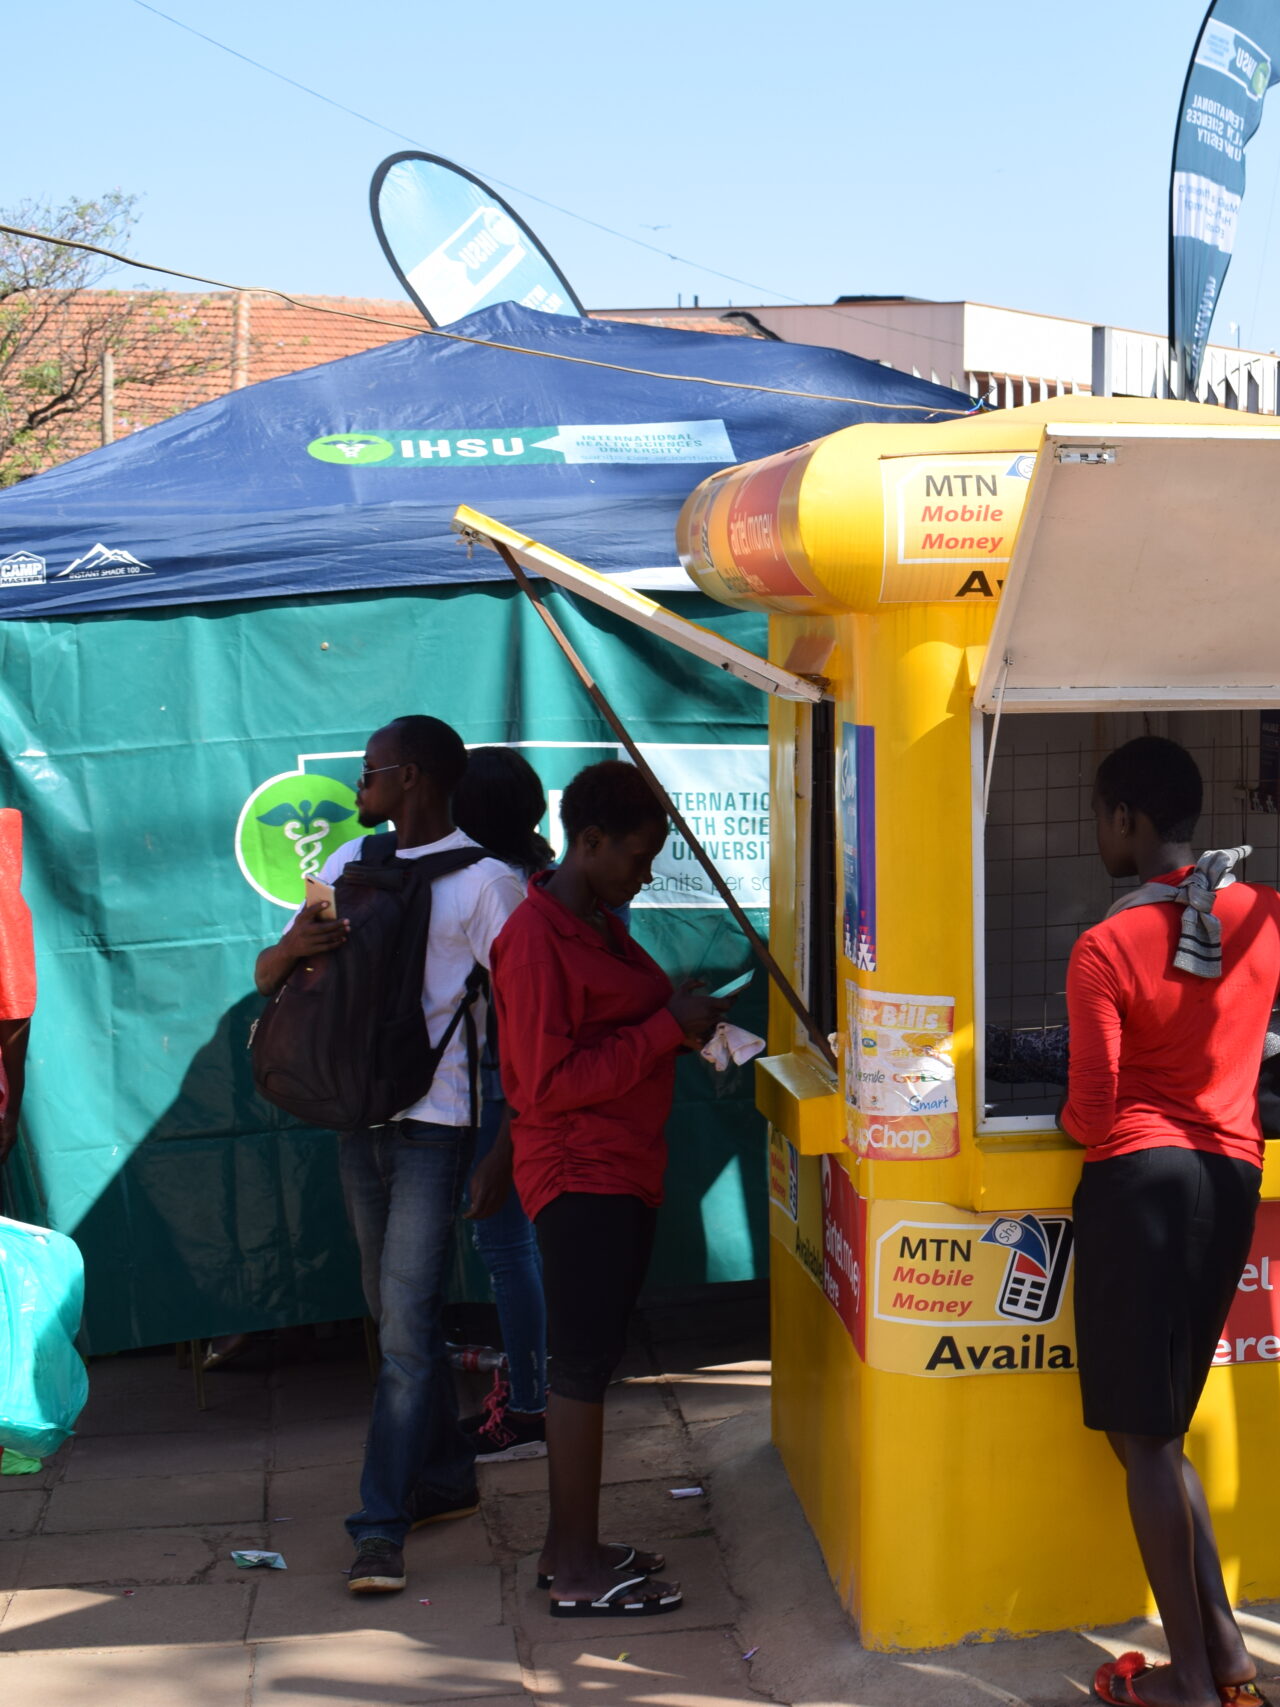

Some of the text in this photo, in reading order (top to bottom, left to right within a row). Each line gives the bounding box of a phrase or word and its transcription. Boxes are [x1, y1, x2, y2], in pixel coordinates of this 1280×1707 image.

[581, 433, 696, 442] INTERNATIONAL
[400, 437, 525, 459] IHSU
[599, 447, 684, 455] UNIVERSITY
[925, 474, 998, 497] MTN
[921, 504, 1004, 522] Mobile
[921, 533, 1004, 553] Money
[1, 563, 43, 577] CAMP
[69, 566, 141, 579] INSTANT SHADE 100
[1, 576, 40, 585] MASTER
[668, 792, 769, 811] TERNATIO
[881, 1003, 940, 1029] Bills
[862, 1069, 886, 1083] smile
[909, 1094, 949, 1112] Smart
[1000, 1221, 1018, 1243] Shs
[899, 1236, 972, 1262] MTN
[825, 1213, 861, 1314] airtel moey
[824, 1258, 840, 1307] Here
[892, 1266, 975, 1287] Mobile
[892, 1293, 973, 1318] Money
[925, 1333, 1079, 1371] Availa
